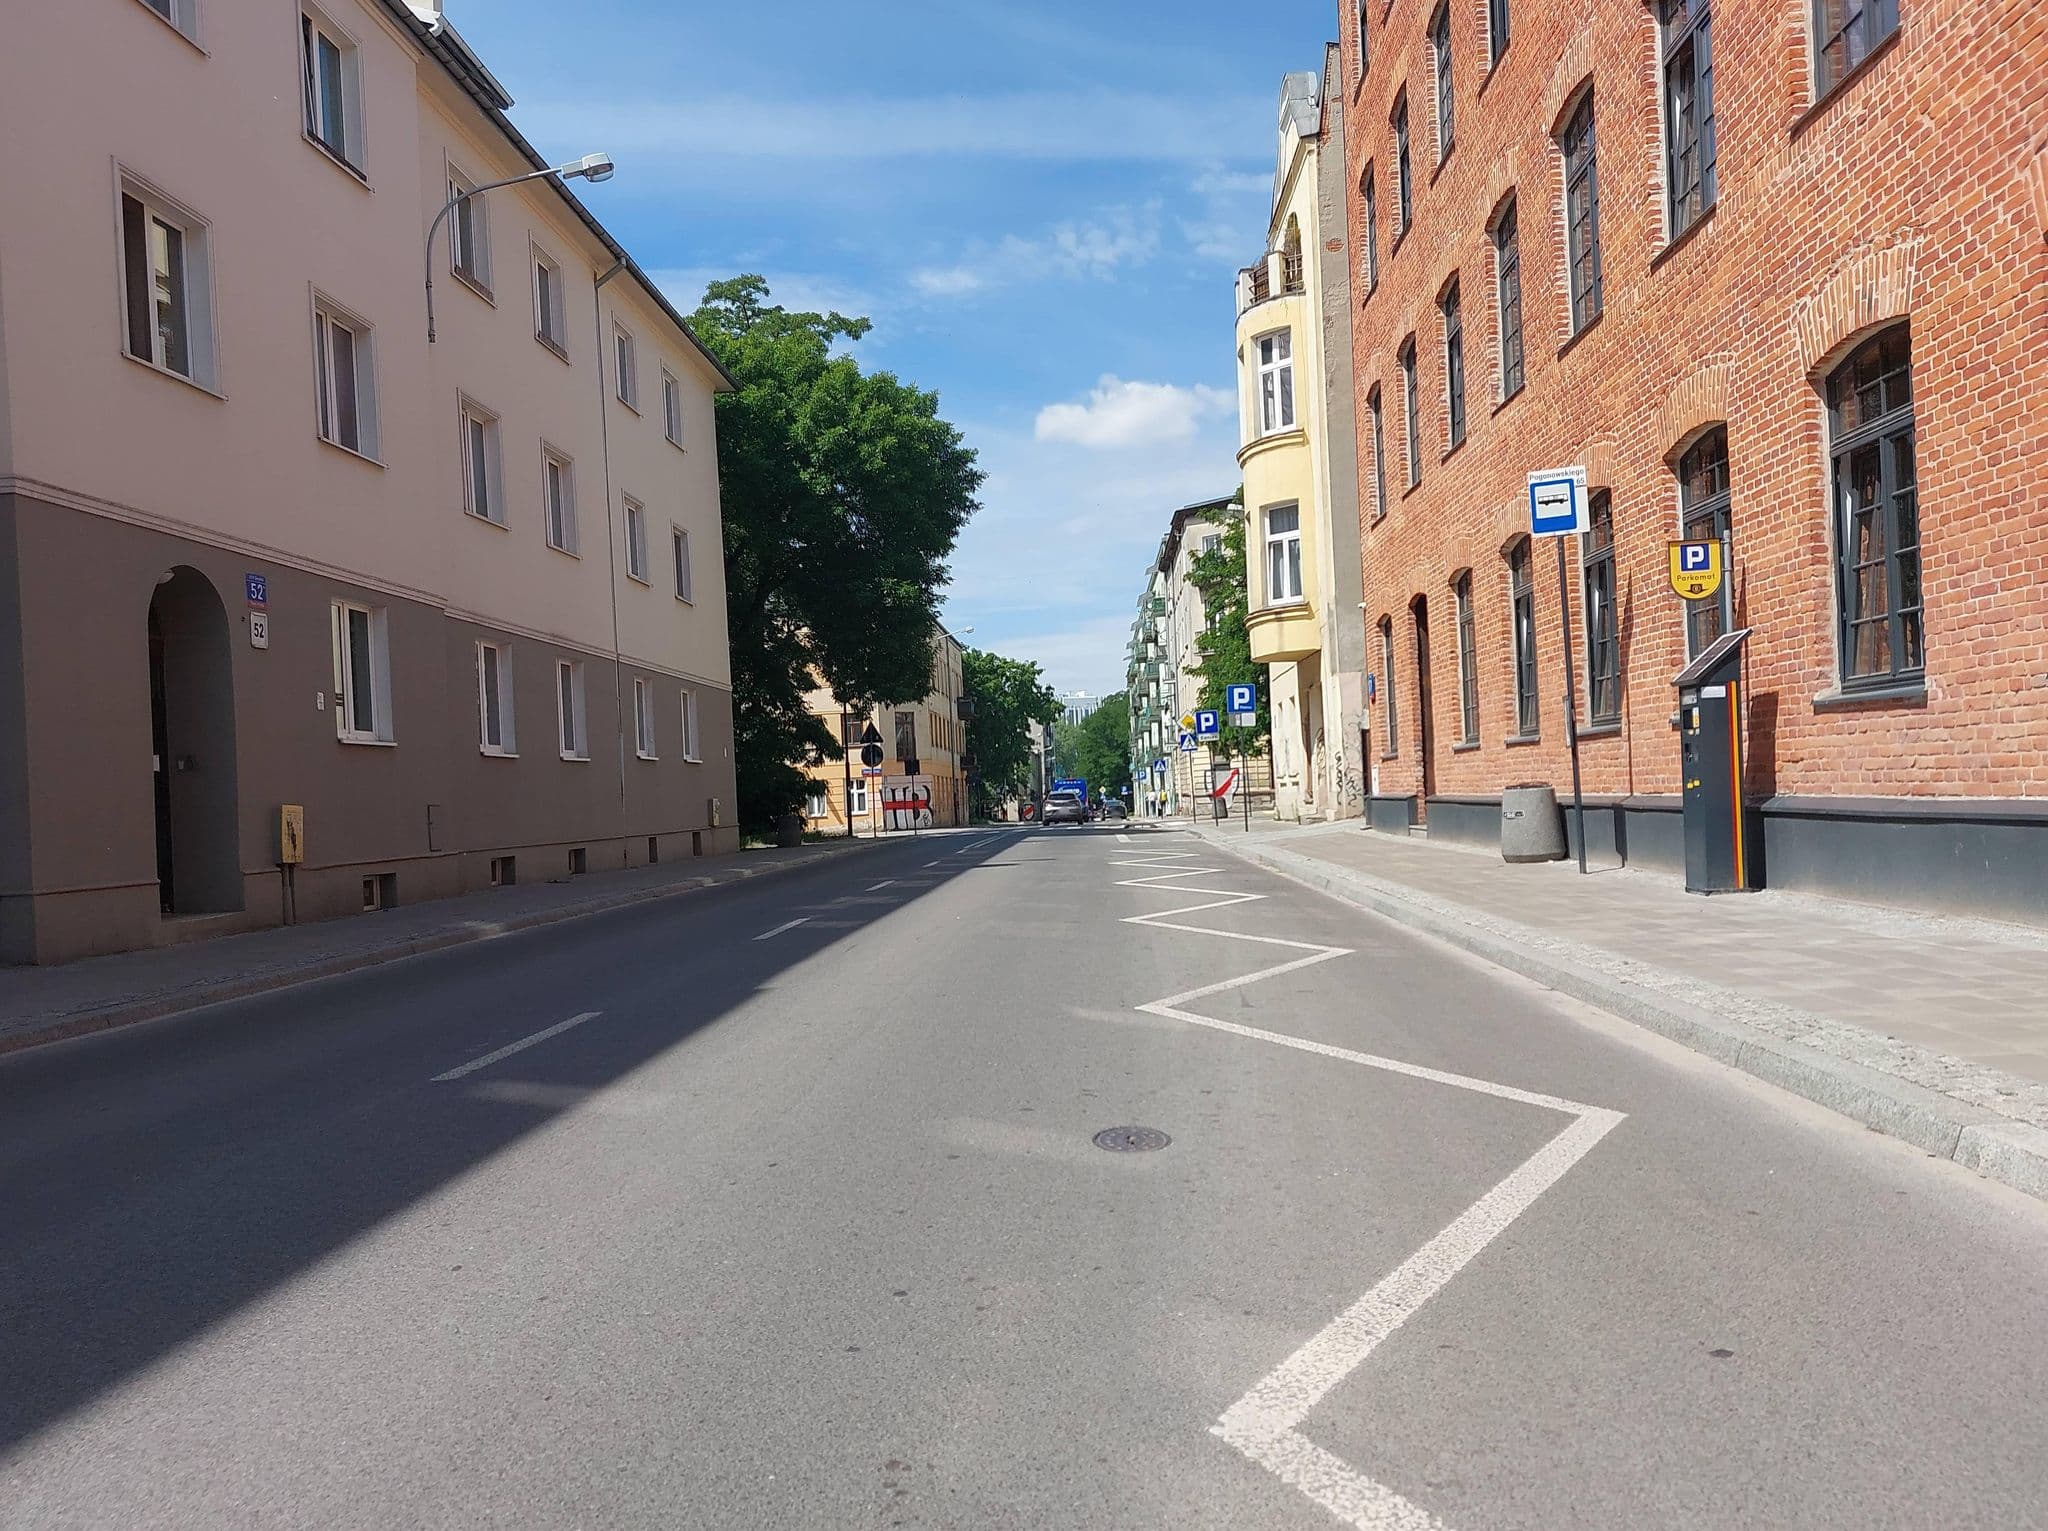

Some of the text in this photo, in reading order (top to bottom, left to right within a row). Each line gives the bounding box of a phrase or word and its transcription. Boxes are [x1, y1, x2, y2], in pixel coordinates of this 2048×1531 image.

[1530, 469, 1584, 481] Pogonowskiego
[1576, 477, 1585, 485] 65
[1686, 545, 1704, 569] P
[1676, 572, 1715, 582] Parkomat
[250, 583, 264, 600] 52
[253, 622, 265, 638] 52
[1233, 687, 1250, 710] P
[1200, 712, 1214, 732] P
